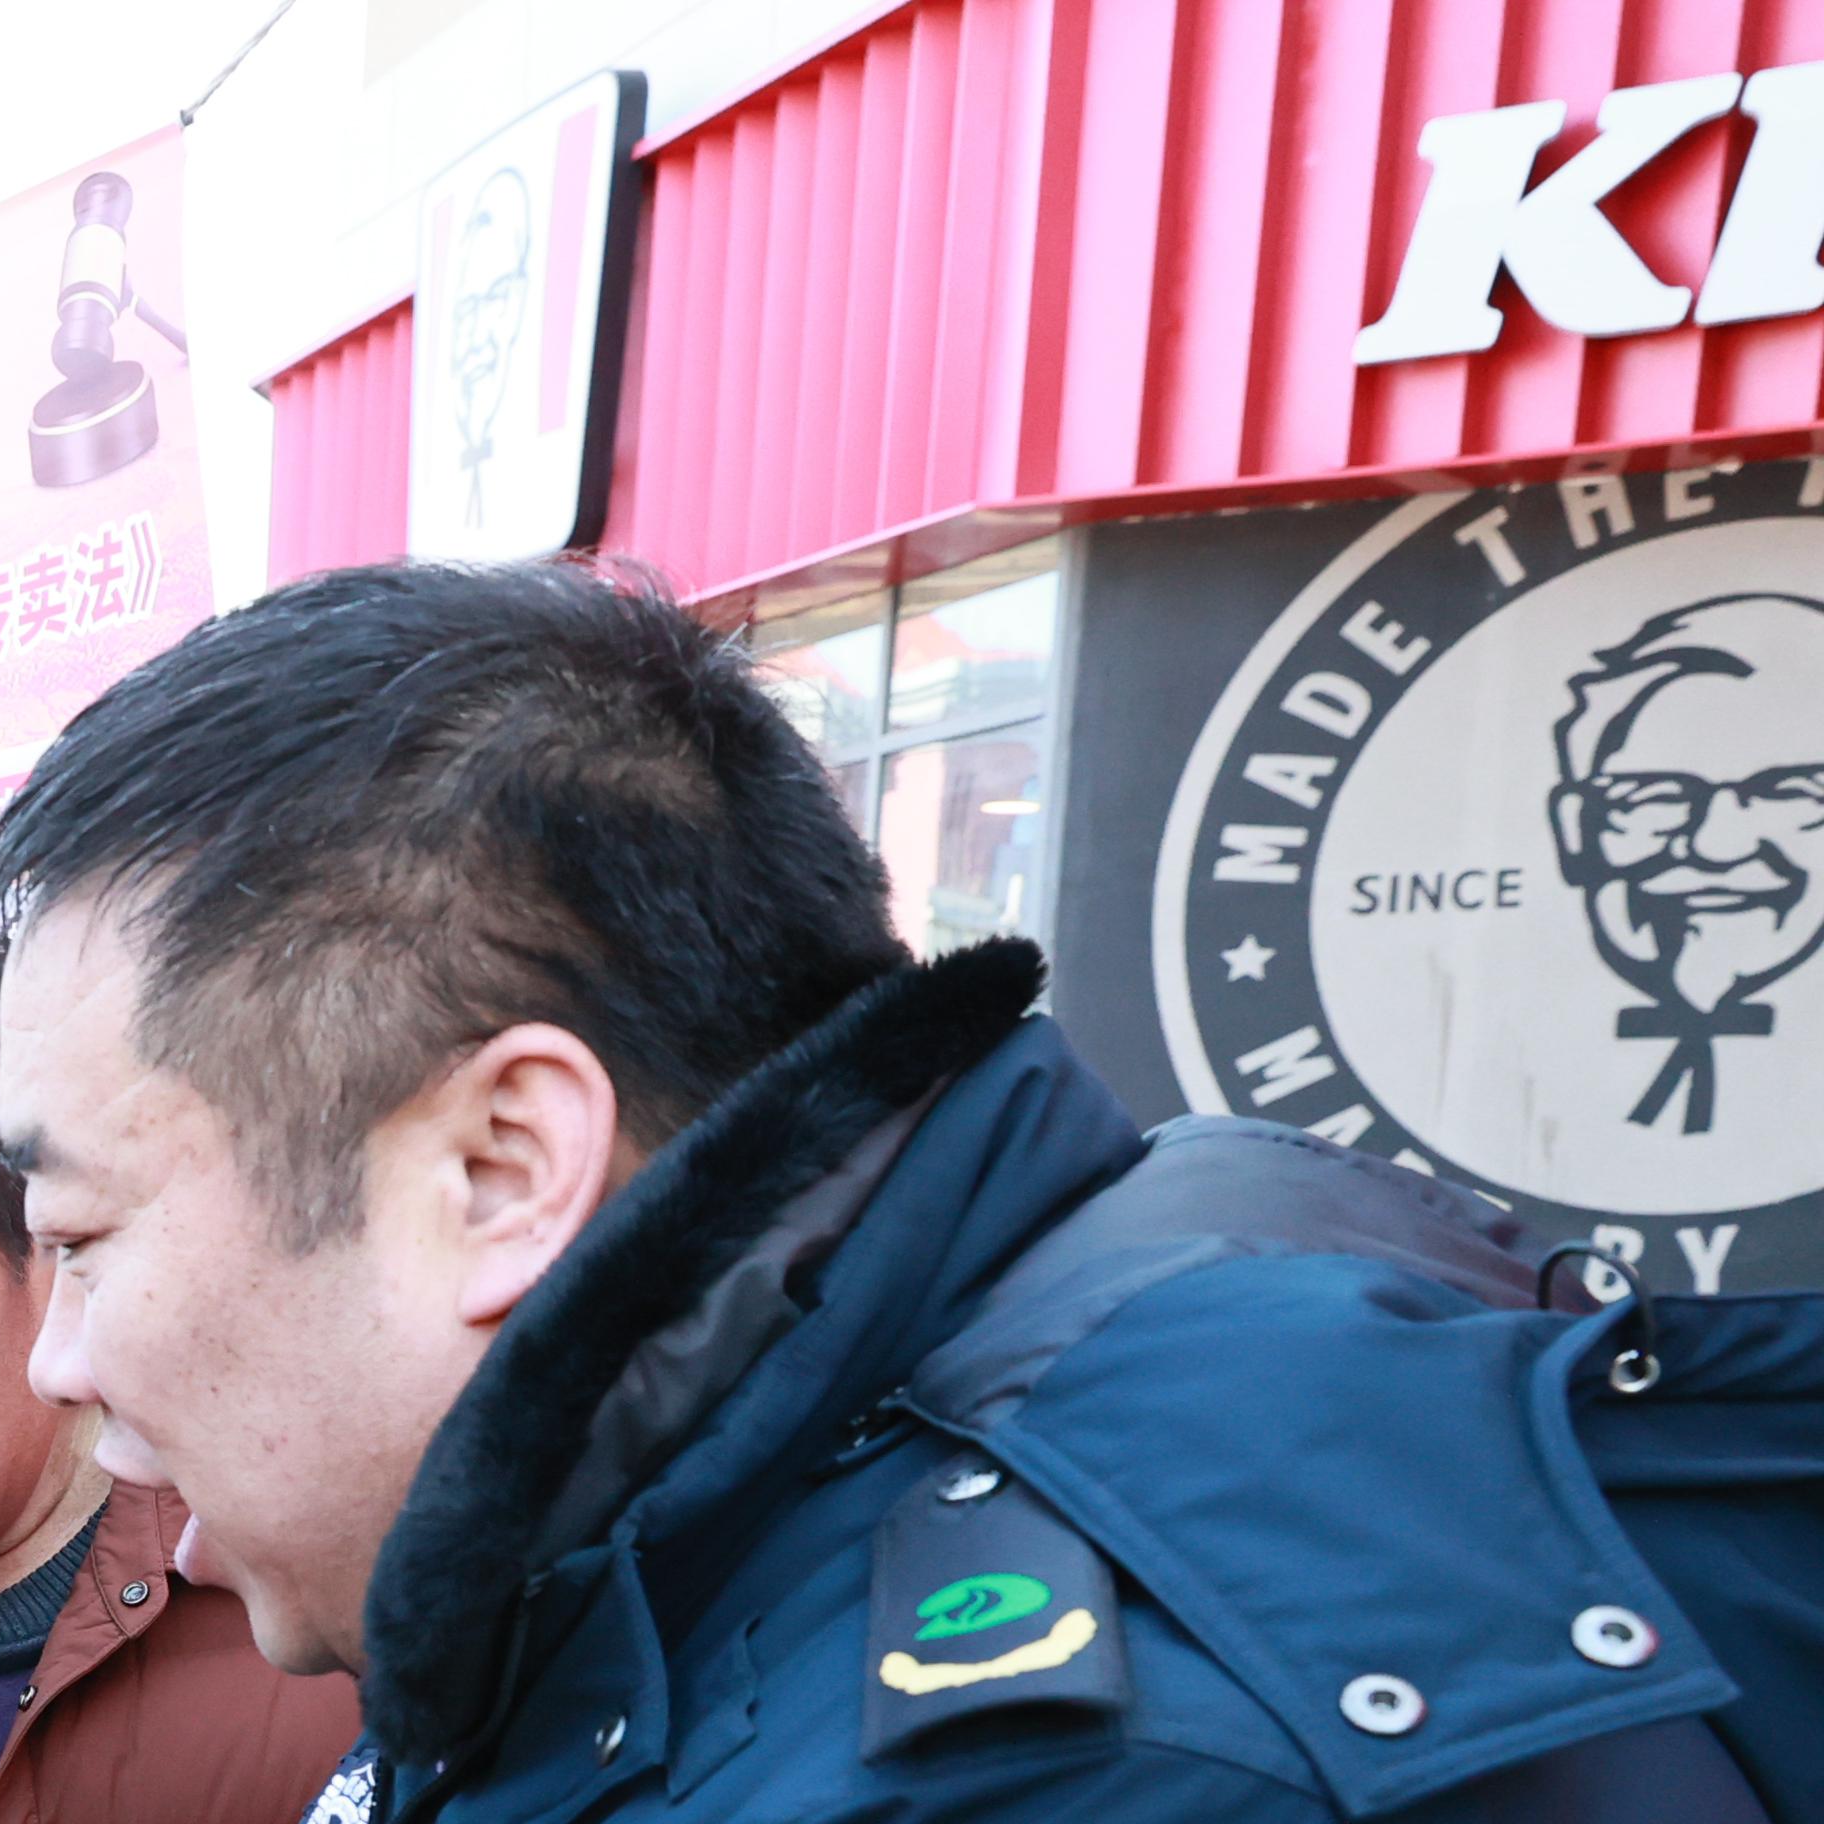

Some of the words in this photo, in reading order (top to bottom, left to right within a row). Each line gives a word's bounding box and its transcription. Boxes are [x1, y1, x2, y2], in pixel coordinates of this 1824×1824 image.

[1213, 600, 1432, 884] MADE
[1350, 868, 1523, 914] SINCE
[1583, 1223, 1741, 1303] BY
